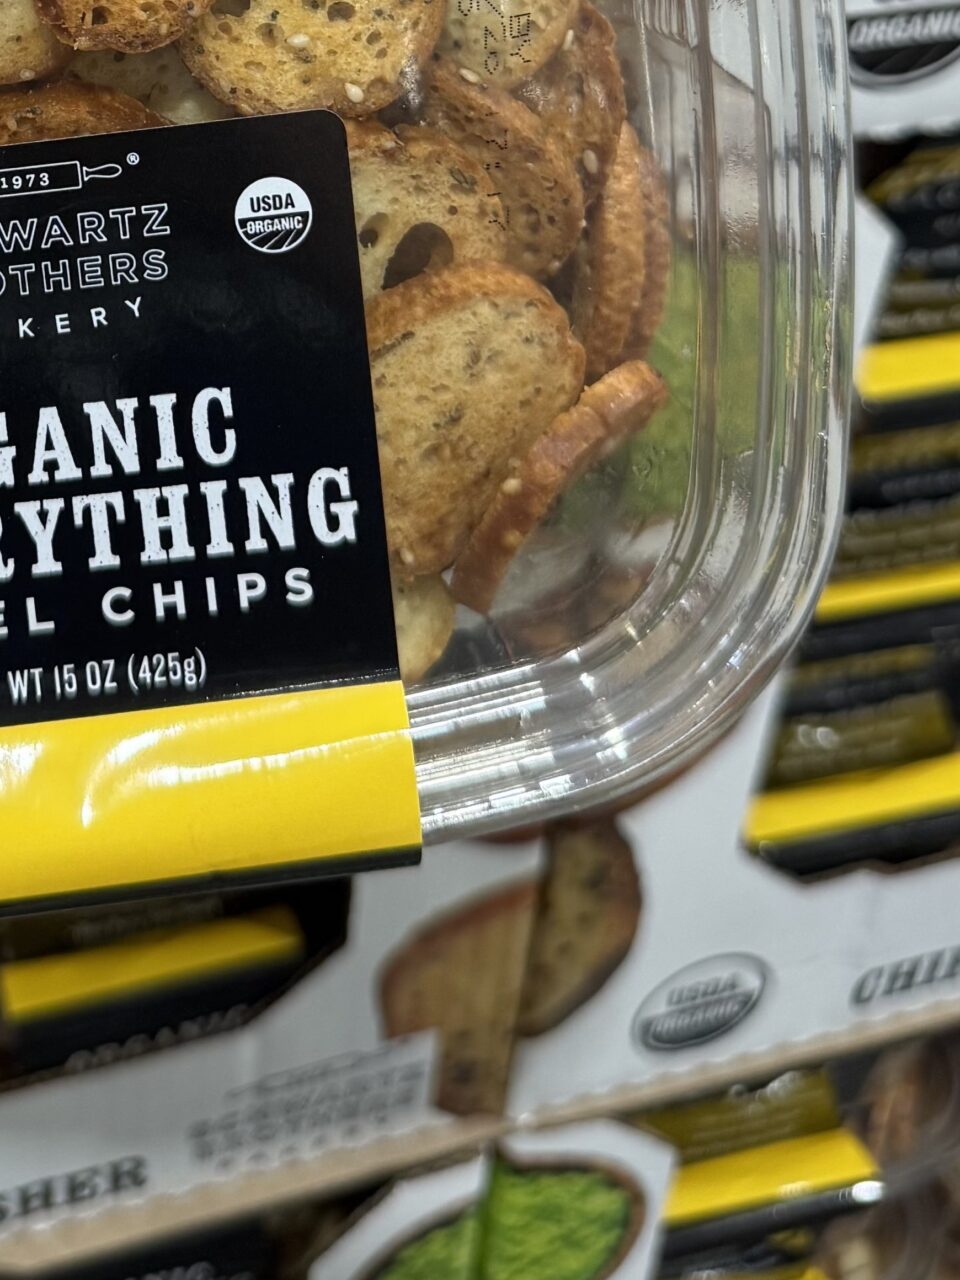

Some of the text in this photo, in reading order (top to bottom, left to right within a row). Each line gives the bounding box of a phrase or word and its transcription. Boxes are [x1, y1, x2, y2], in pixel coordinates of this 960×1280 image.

[509, 12, 532, 64] BY
[0, 173, 50, 190] 1973
[249, 192, 296, 214] USDA
[246, 216, 304, 235] ORGANIC
[102, 568, 313, 623] CHIPS
[8, 668, 43, 702] WT
[54, 664, 78, 696] 15
[86, 660, 118, 691] OZ
[127, 648, 206, 691] (425g)
